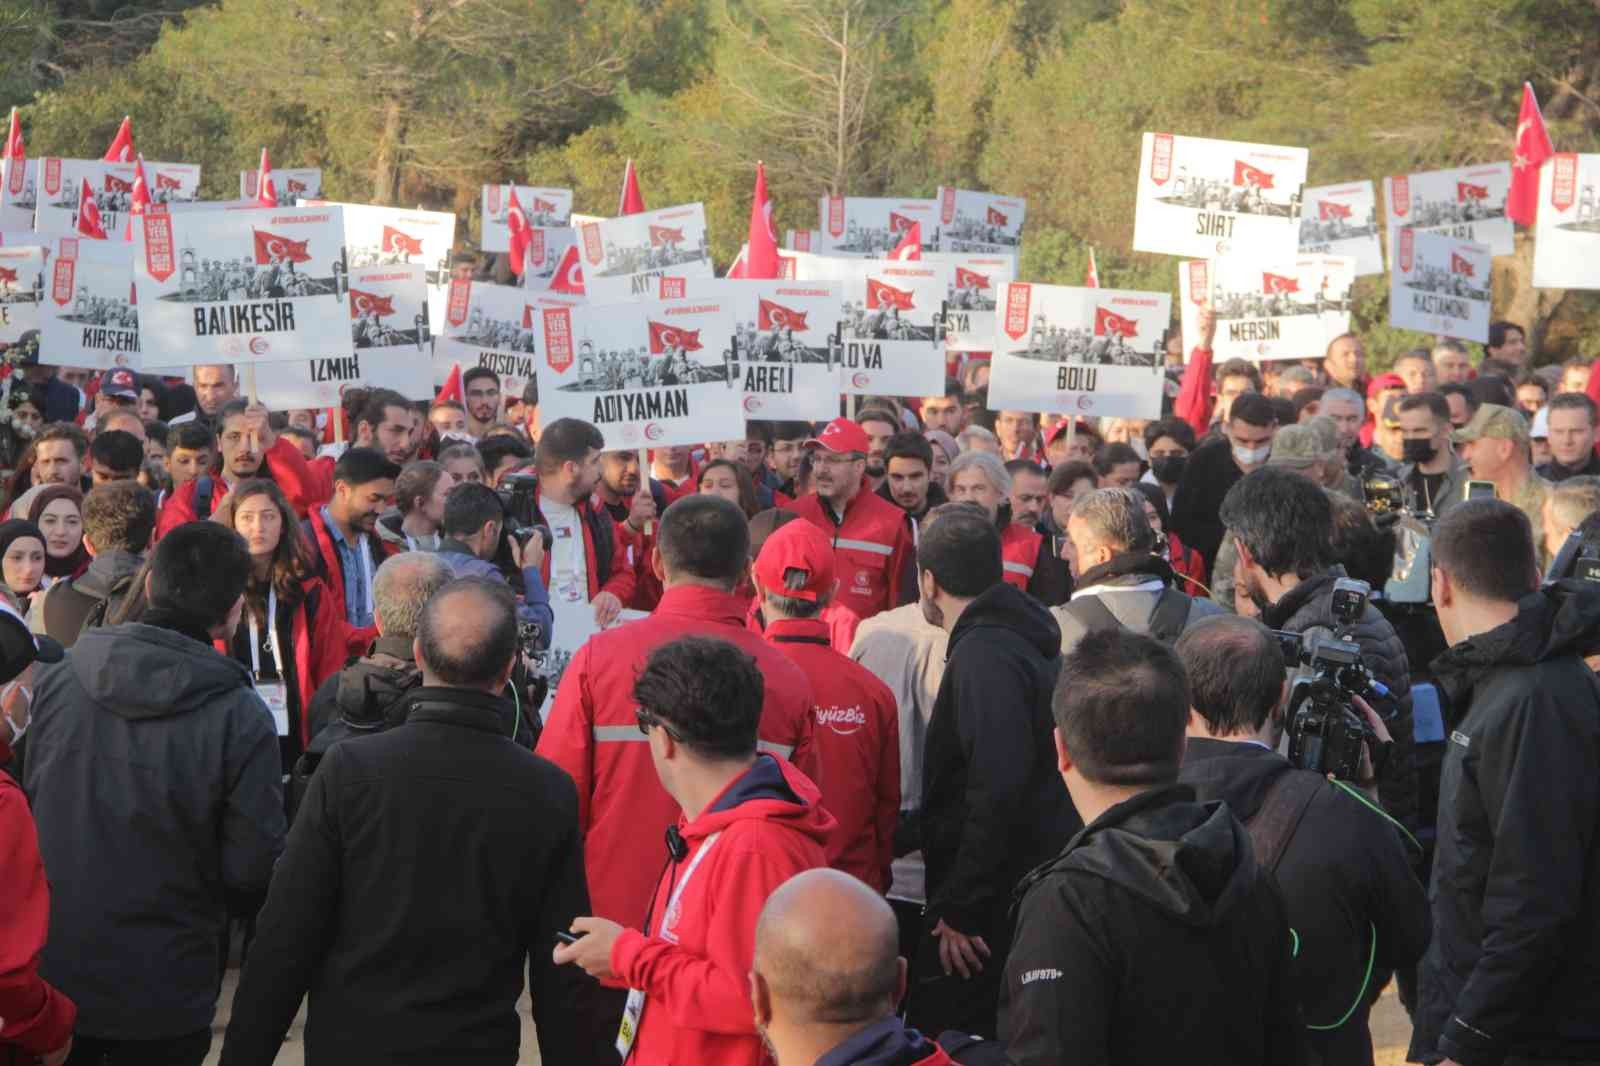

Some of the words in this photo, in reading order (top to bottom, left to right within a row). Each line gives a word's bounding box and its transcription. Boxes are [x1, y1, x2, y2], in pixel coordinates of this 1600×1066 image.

[194, 299, 295, 336] BALIKESİR
[1057, 366, 1097, 392] BOLU
[593, 388, 689, 423] ADIYAMAN
